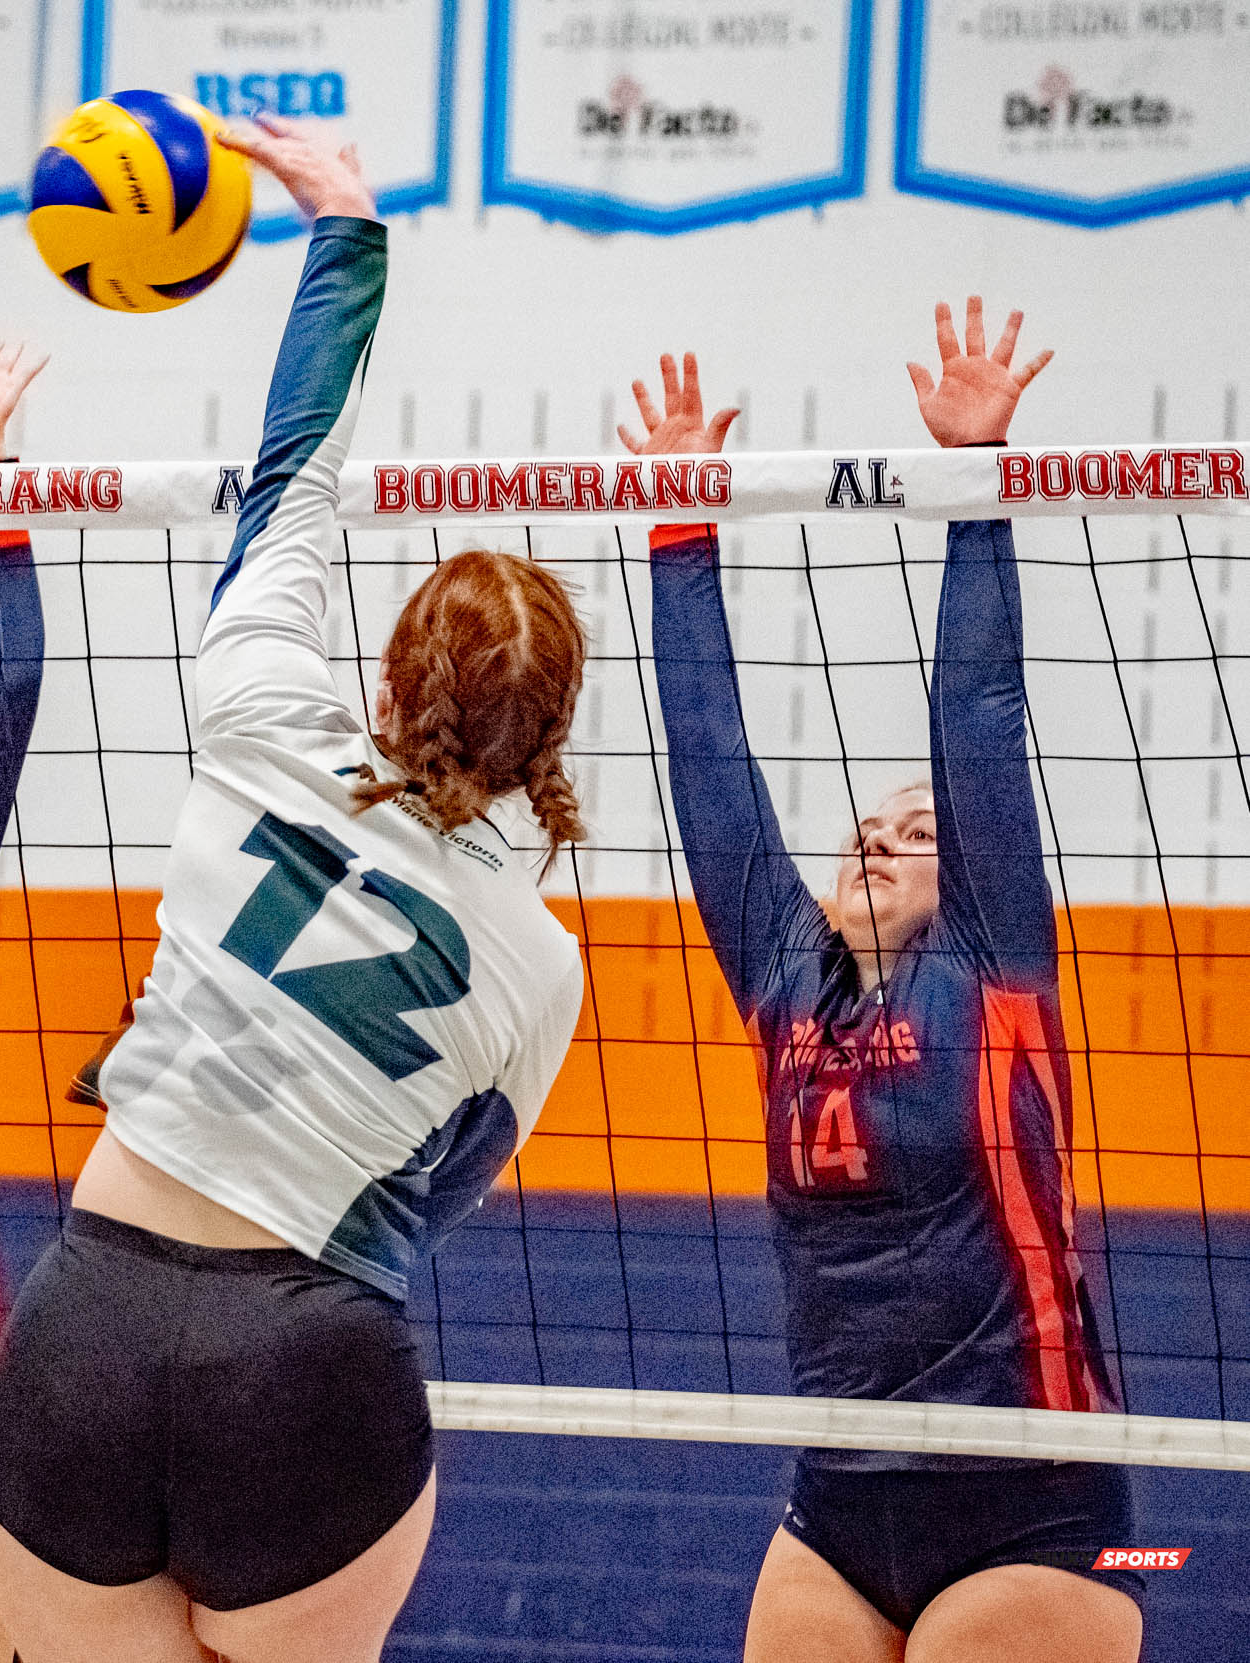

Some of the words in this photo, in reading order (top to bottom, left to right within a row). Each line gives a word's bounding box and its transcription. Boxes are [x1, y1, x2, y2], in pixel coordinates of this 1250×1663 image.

[194, 69, 347, 118] RSEQ
[374, 460, 732, 514] BOOMERANG
[997, 448, 1250, 504] BOOMER
[218, 810, 471, 1083] 12
[787, 1086, 869, 1188] 14
